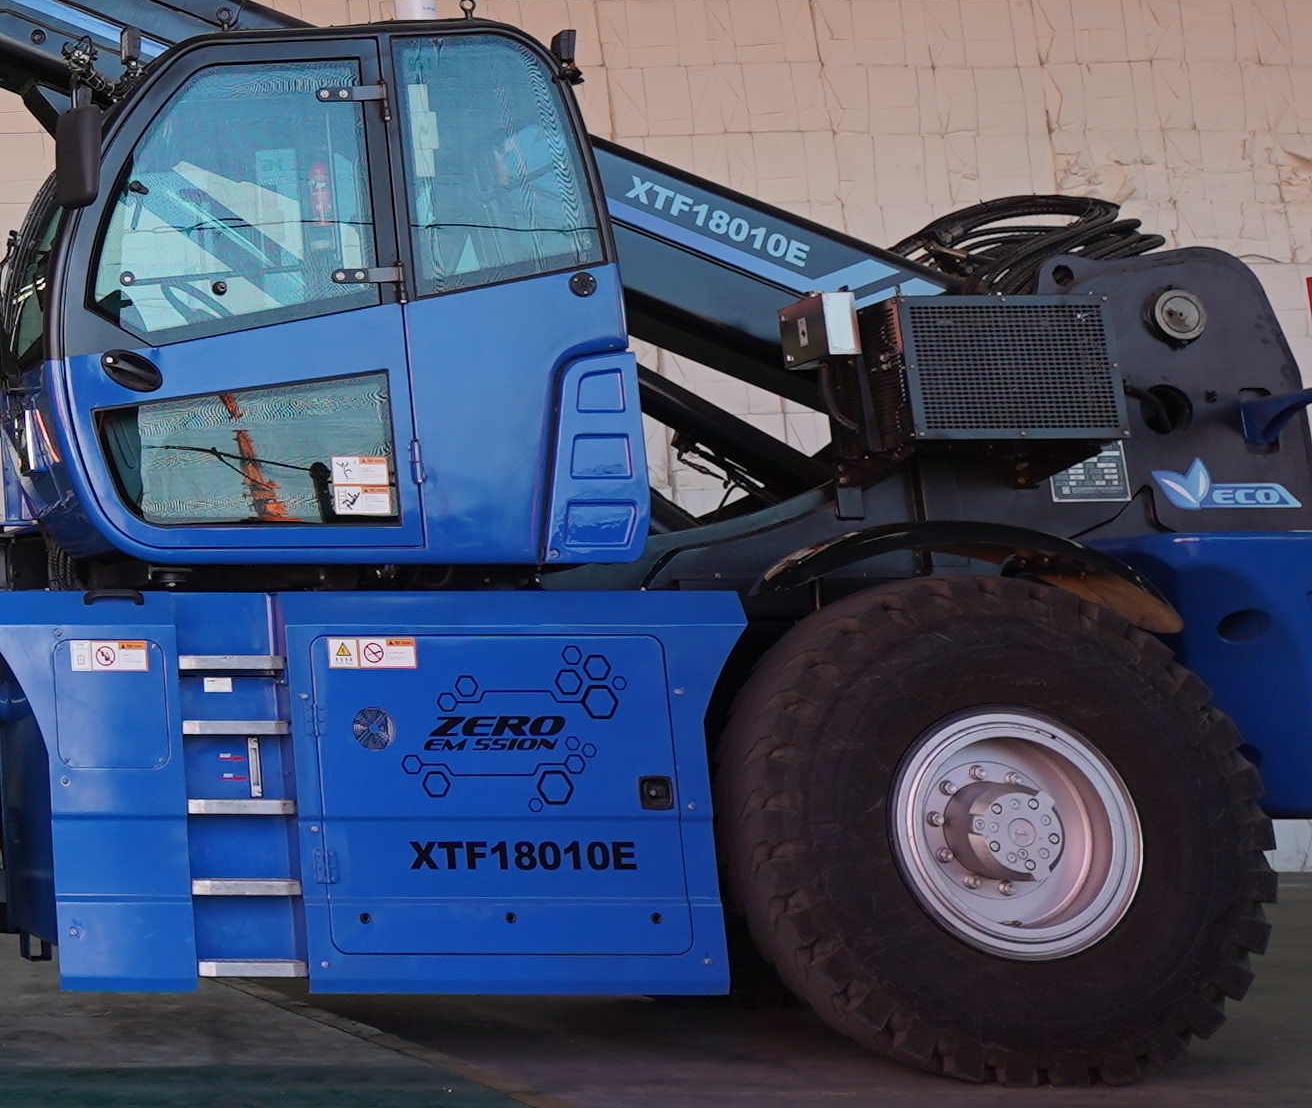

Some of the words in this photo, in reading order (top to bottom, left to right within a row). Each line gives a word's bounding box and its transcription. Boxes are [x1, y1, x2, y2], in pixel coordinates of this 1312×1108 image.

[625, 175, 811, 267] XTF18010E
[1212, 489, 1280, 504] ECO
[429, 715, 565, 737] ZERO
[409, 841, 637, 870] XTF18010E
